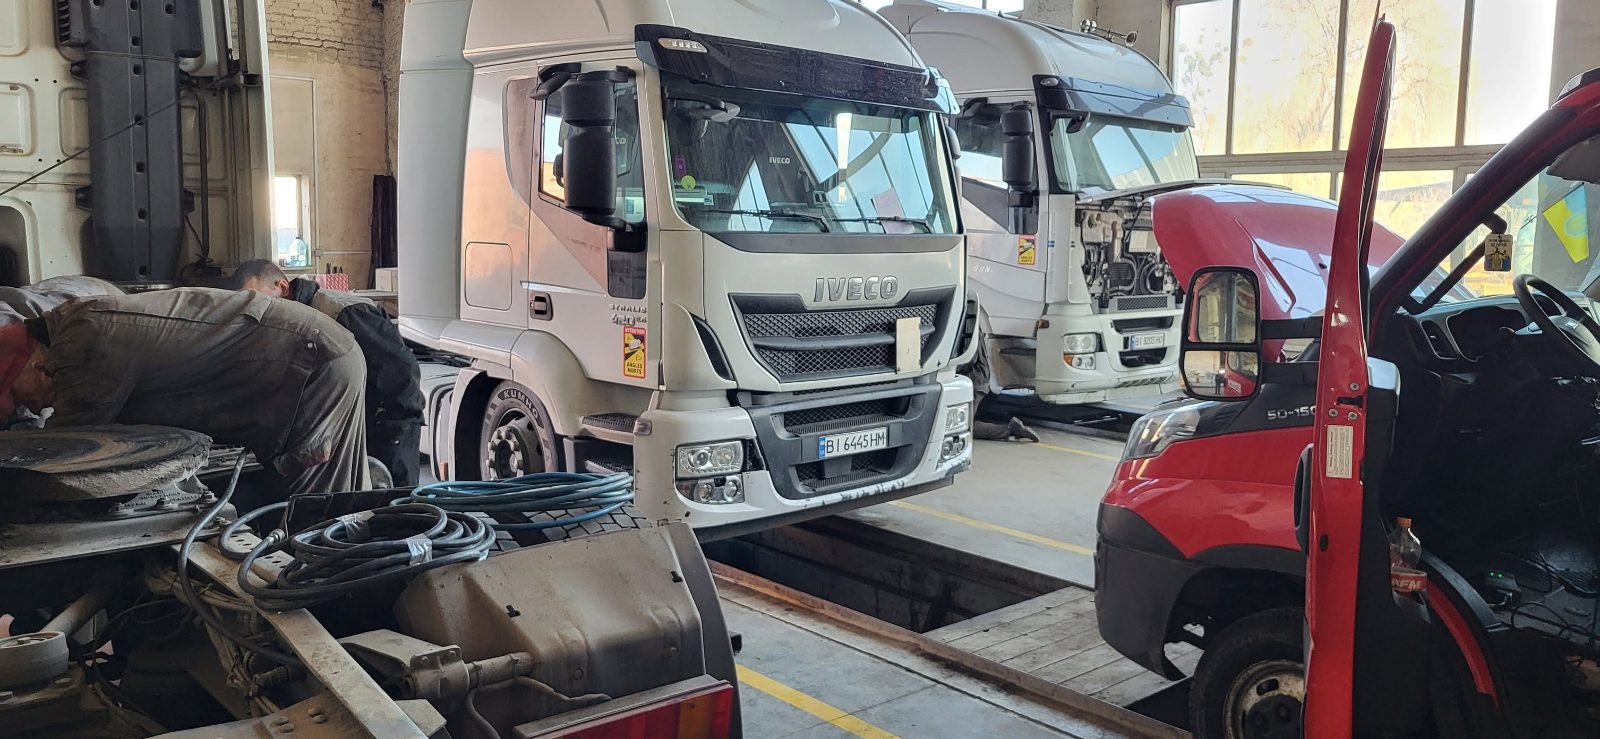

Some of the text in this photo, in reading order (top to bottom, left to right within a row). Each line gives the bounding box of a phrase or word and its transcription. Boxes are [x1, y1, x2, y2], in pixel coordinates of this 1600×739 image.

[769, 156, 791, 164] IVECO
[813, 275, 898, 302] IVECO
[611, 313, 636, 326] 420
[626, 361, 643, 369] ANGLES
[627, 367, 642, 375] MORTS
[503, 388, 540, 419] KUMHO
[826, 431, 885, 454] BI 6445 HM
